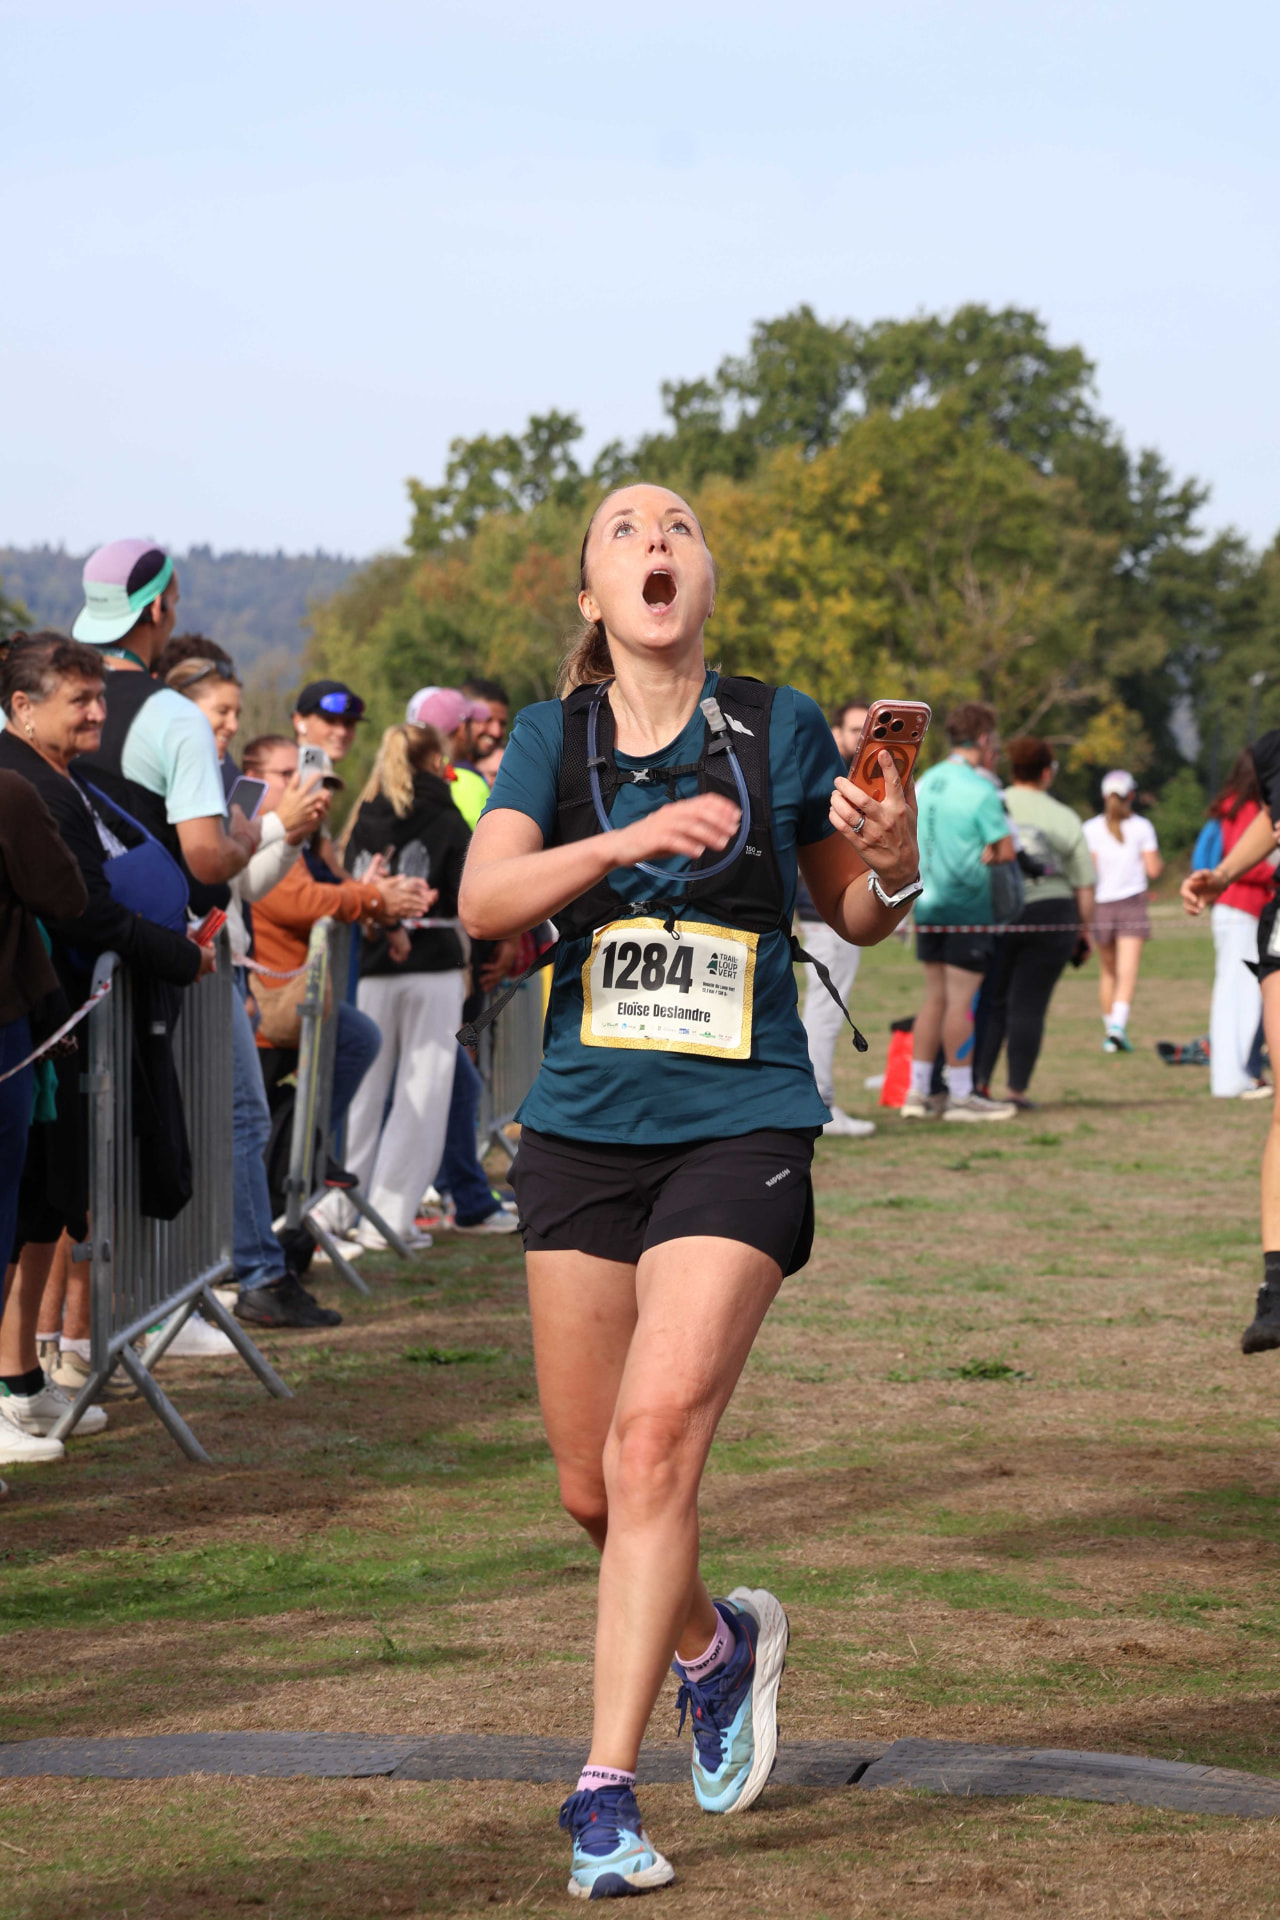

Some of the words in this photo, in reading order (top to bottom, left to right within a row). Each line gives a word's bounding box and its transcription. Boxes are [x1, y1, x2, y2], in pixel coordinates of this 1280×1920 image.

[720, 953, 737, 963] TRAIL
[602, 941, 694, 994] 1284
[718, 960, 738, 971] LOUP
[718, 969, 738, 980] VERT
[617, 1001, 650, 1017] Eloïse
[653, 1004, 711, 1023] Deslandre
